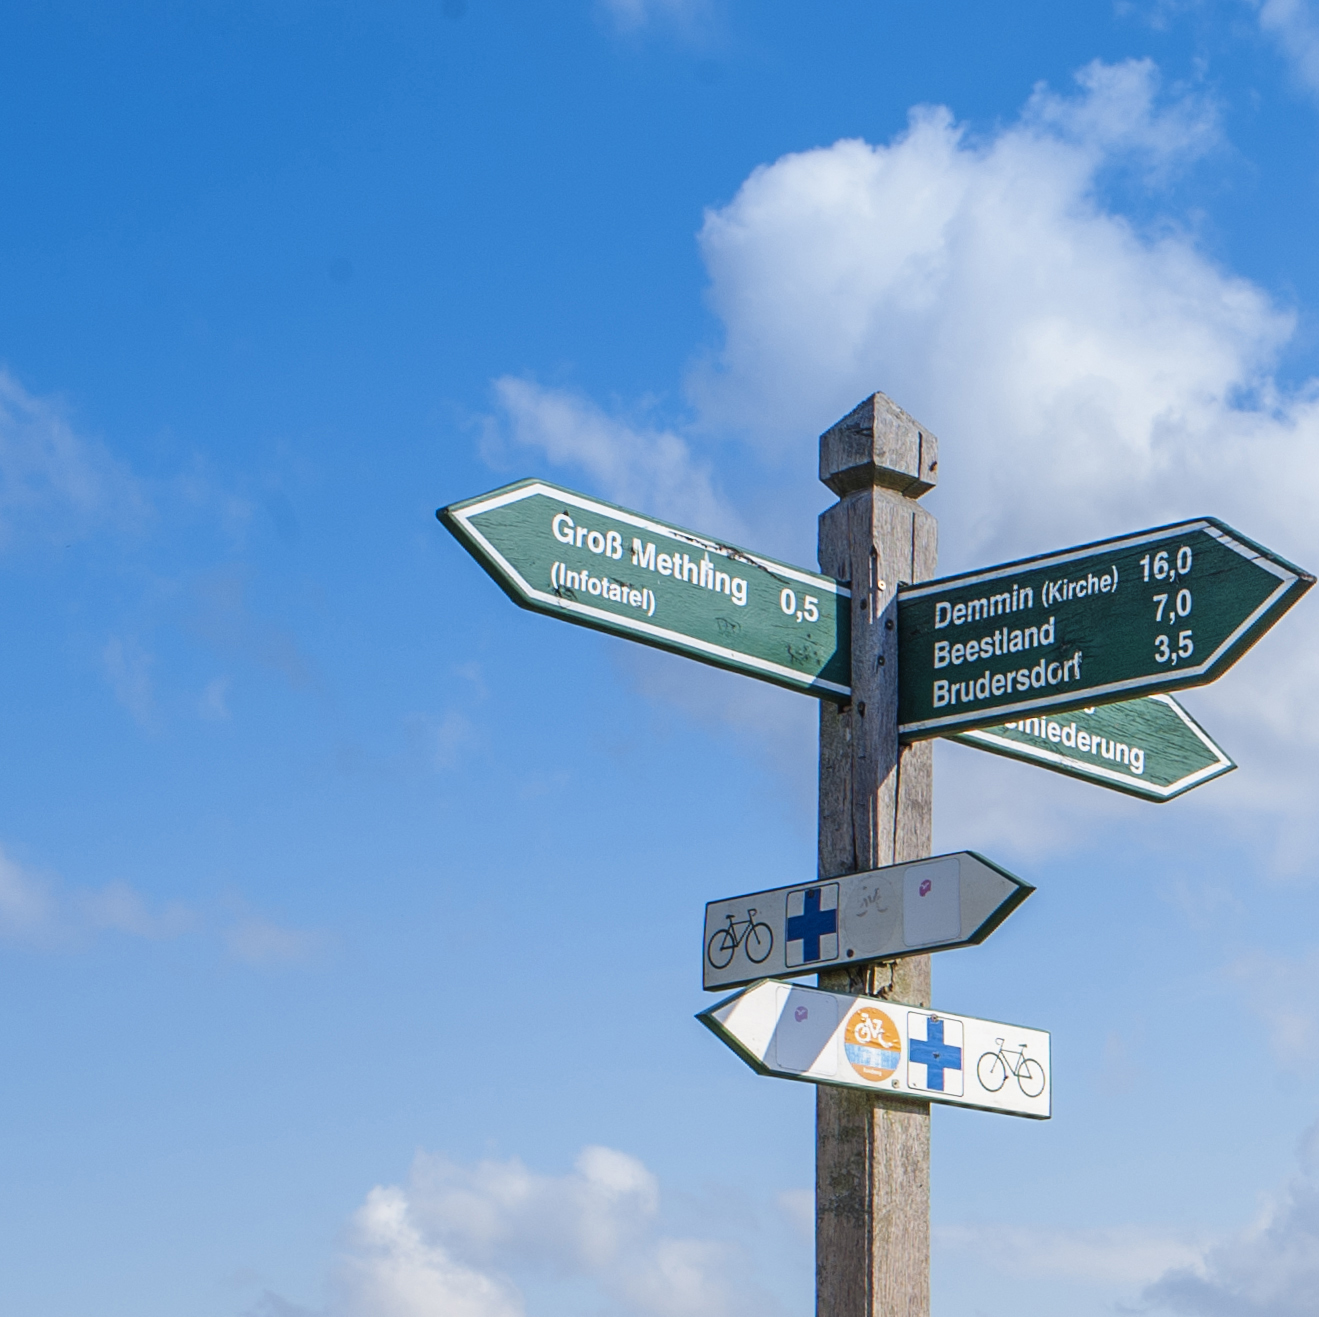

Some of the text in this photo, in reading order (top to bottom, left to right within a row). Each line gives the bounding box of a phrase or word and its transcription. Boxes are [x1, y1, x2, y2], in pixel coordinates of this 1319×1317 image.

[551, 561, 656, 617] (Infotafel)
[552, 513, 819, 623] Groß Methling 0,5
[934, 546, 1192, 629] Demmin (Kirche) 16,0
[933, 629, 1194, 708] Brudersdorf 3,5
[934, 588, 1192, 669] Beestland 7,0
[1004, 716, 1145, 775] niederung
